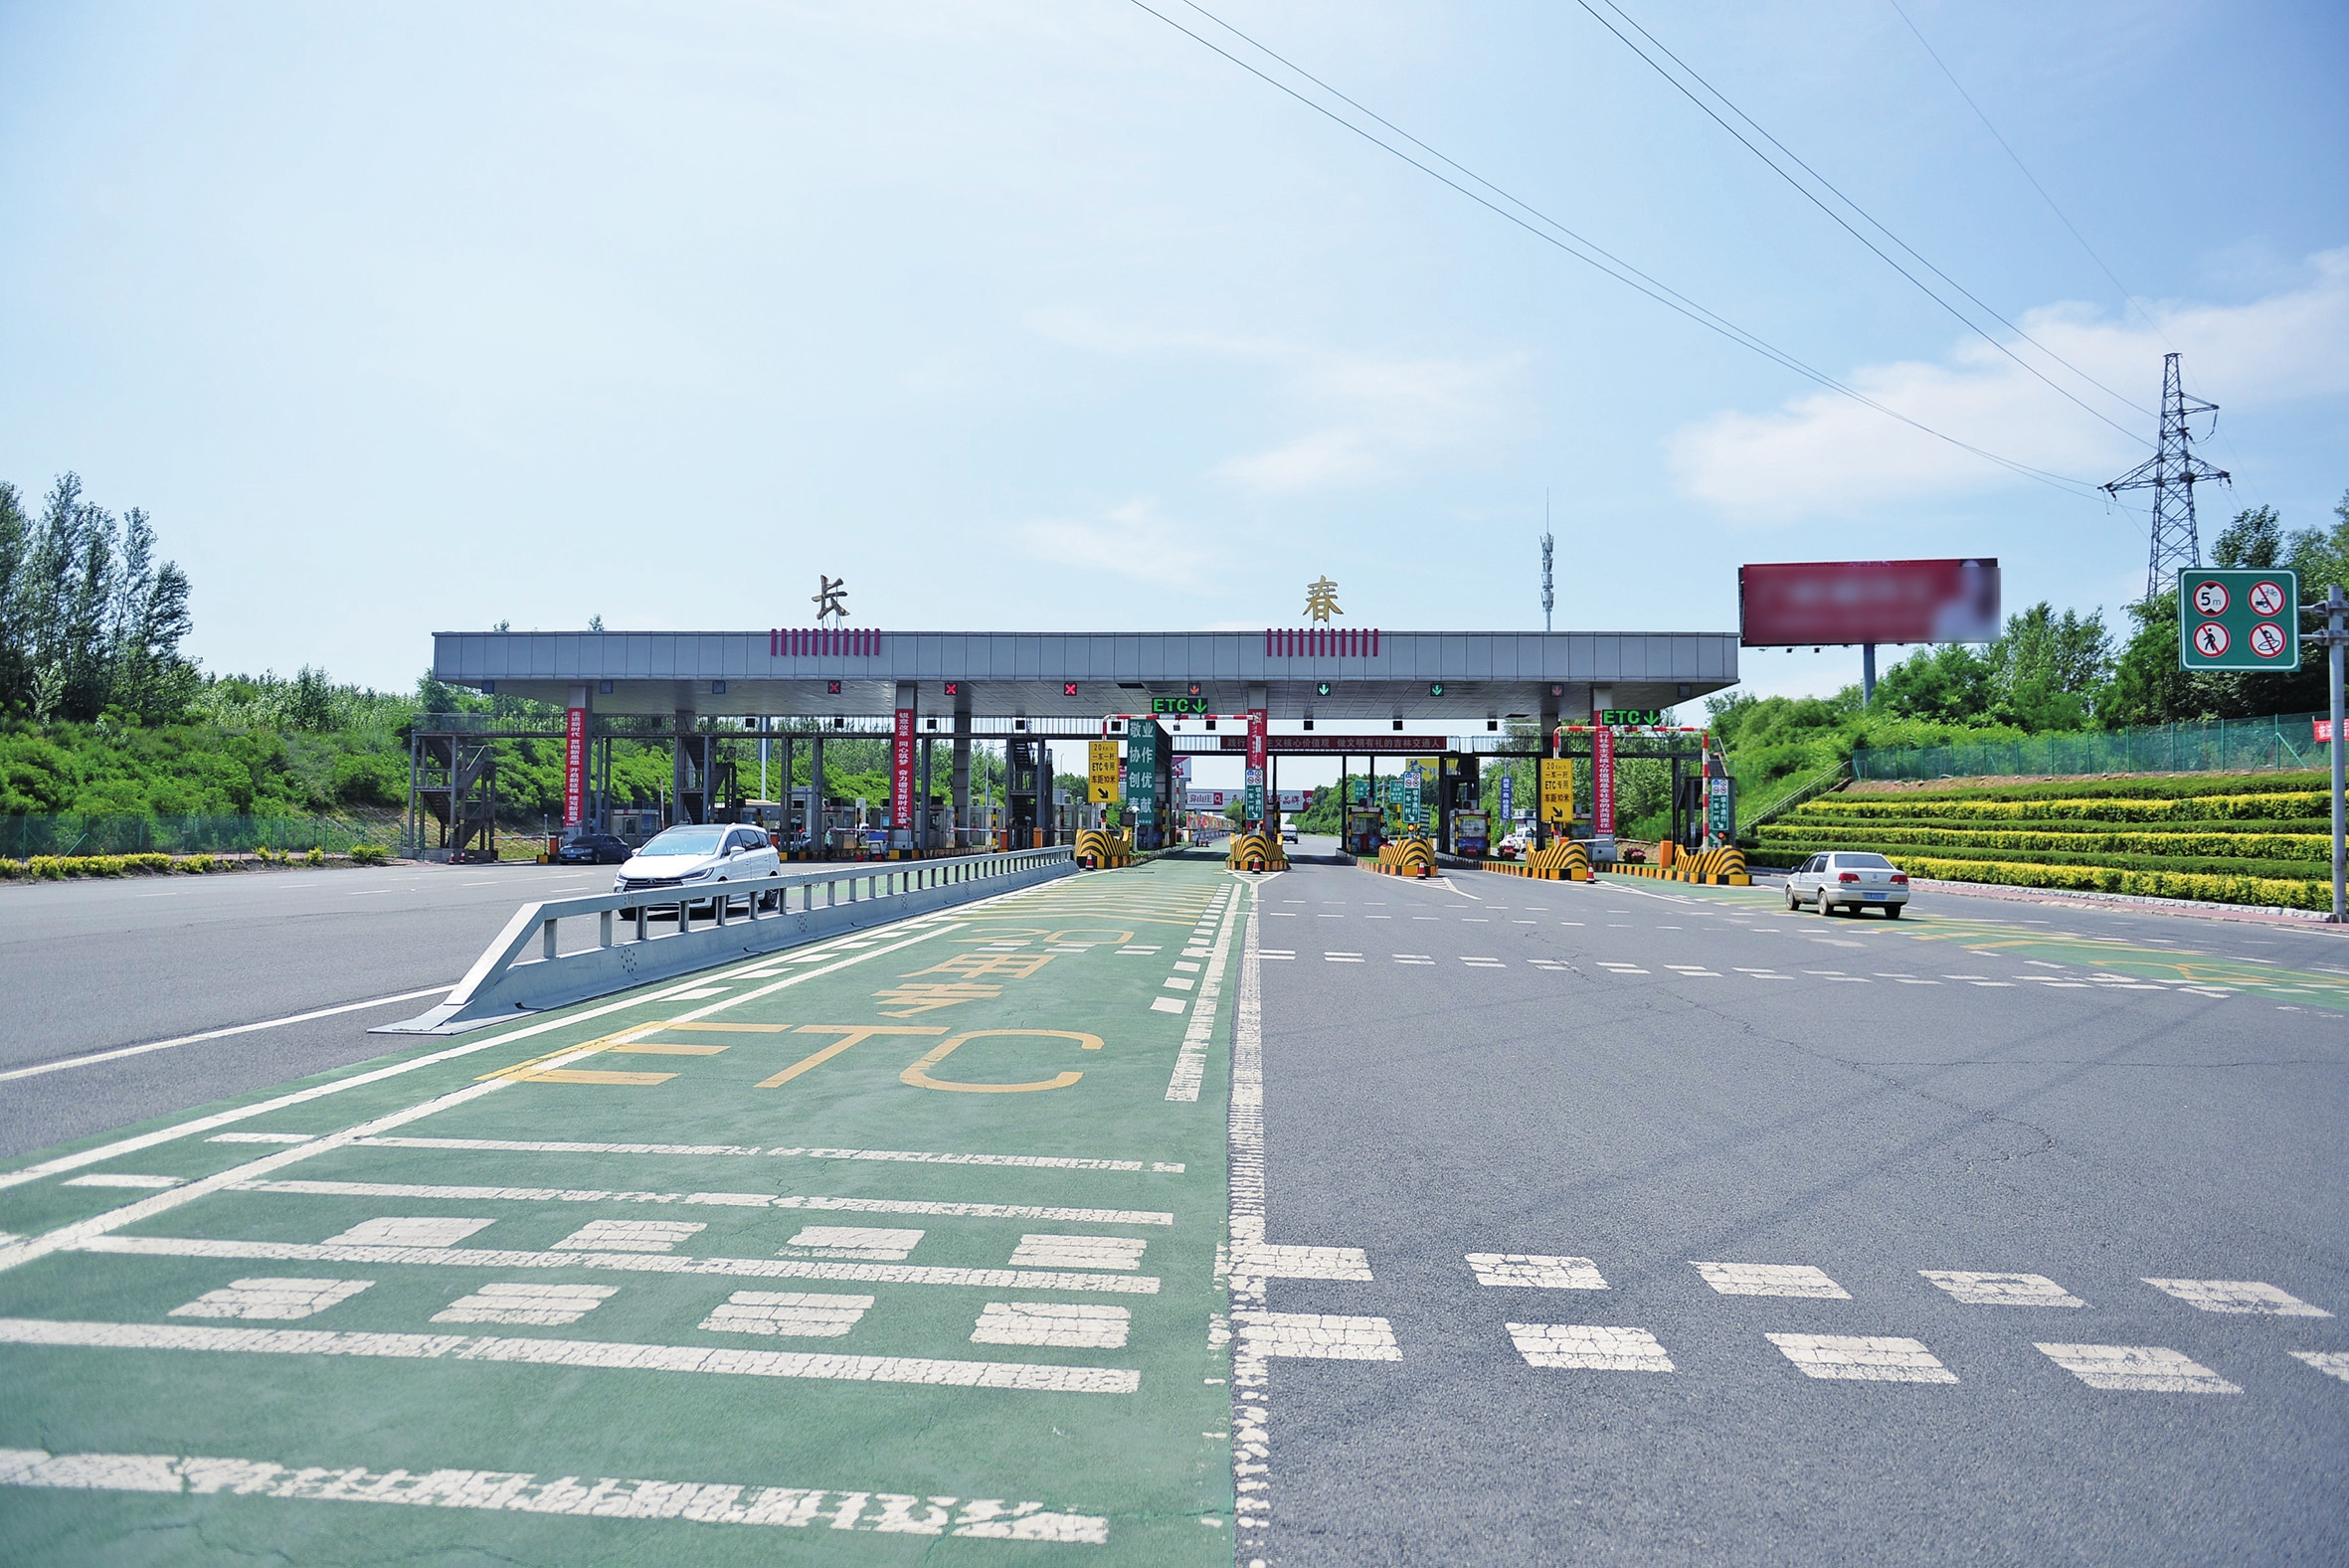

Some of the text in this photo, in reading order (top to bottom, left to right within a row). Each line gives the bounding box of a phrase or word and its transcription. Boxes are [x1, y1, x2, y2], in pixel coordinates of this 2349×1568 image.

[812, 575, 1344, 622] 长 春
[1154, 698, 1188, 712] ETC
[1603, 710, 1640, 724] ETC
[1129, 721, 1154, 738] 敬业
[1227, 738, 1330, 748] 践行主义核心价值观
[1129, 746, 1154, 764] 协作
[1128, 772, 1153, 788] 创优
[474, 1021, 1105, 1093] ETC
